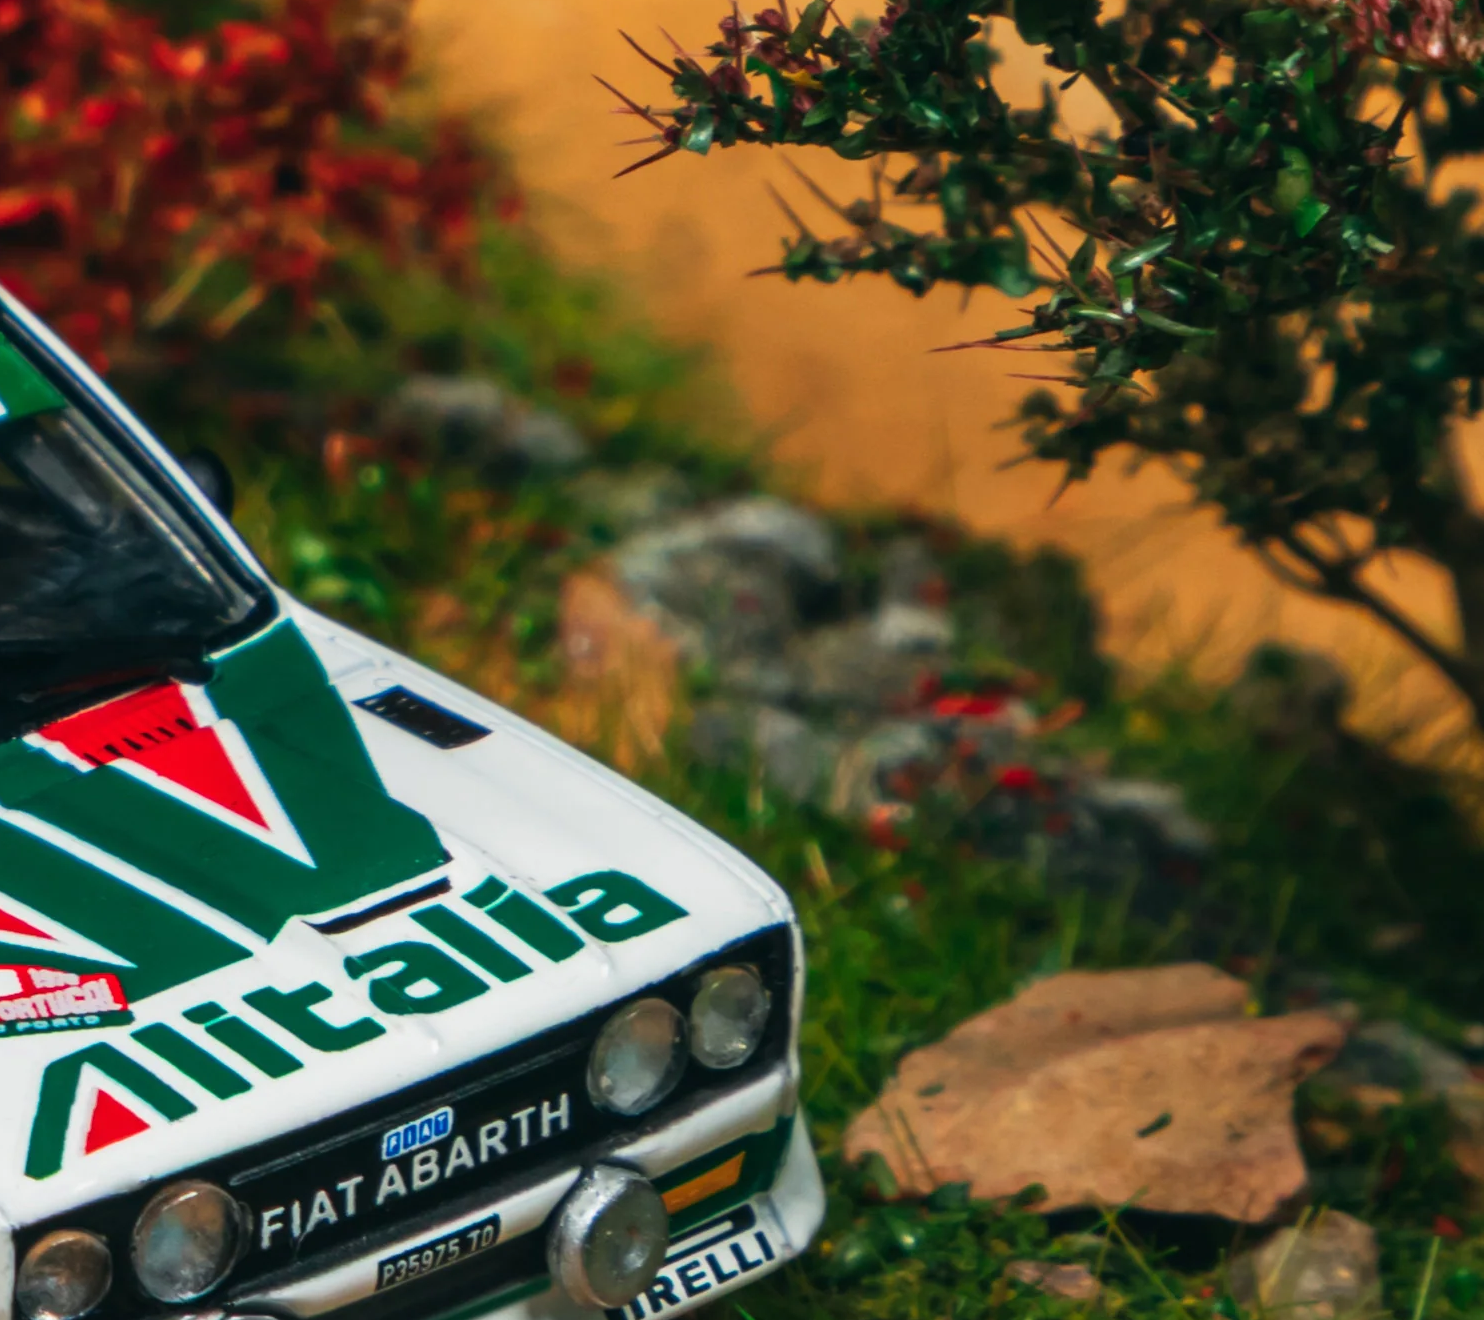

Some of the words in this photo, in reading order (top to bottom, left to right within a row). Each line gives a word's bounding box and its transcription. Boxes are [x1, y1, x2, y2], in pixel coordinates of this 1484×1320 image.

[16, 1014, 101, 1031] PORTO
[23, 870, 689, 1180] Alitalia
[384, 1109, 452, 1158] FIAT
[260, 1175, 364, 1250] FIAT
[375, 1092, 570, 1206] ABARTH
[382, 1237, 460, 1286] P35975
